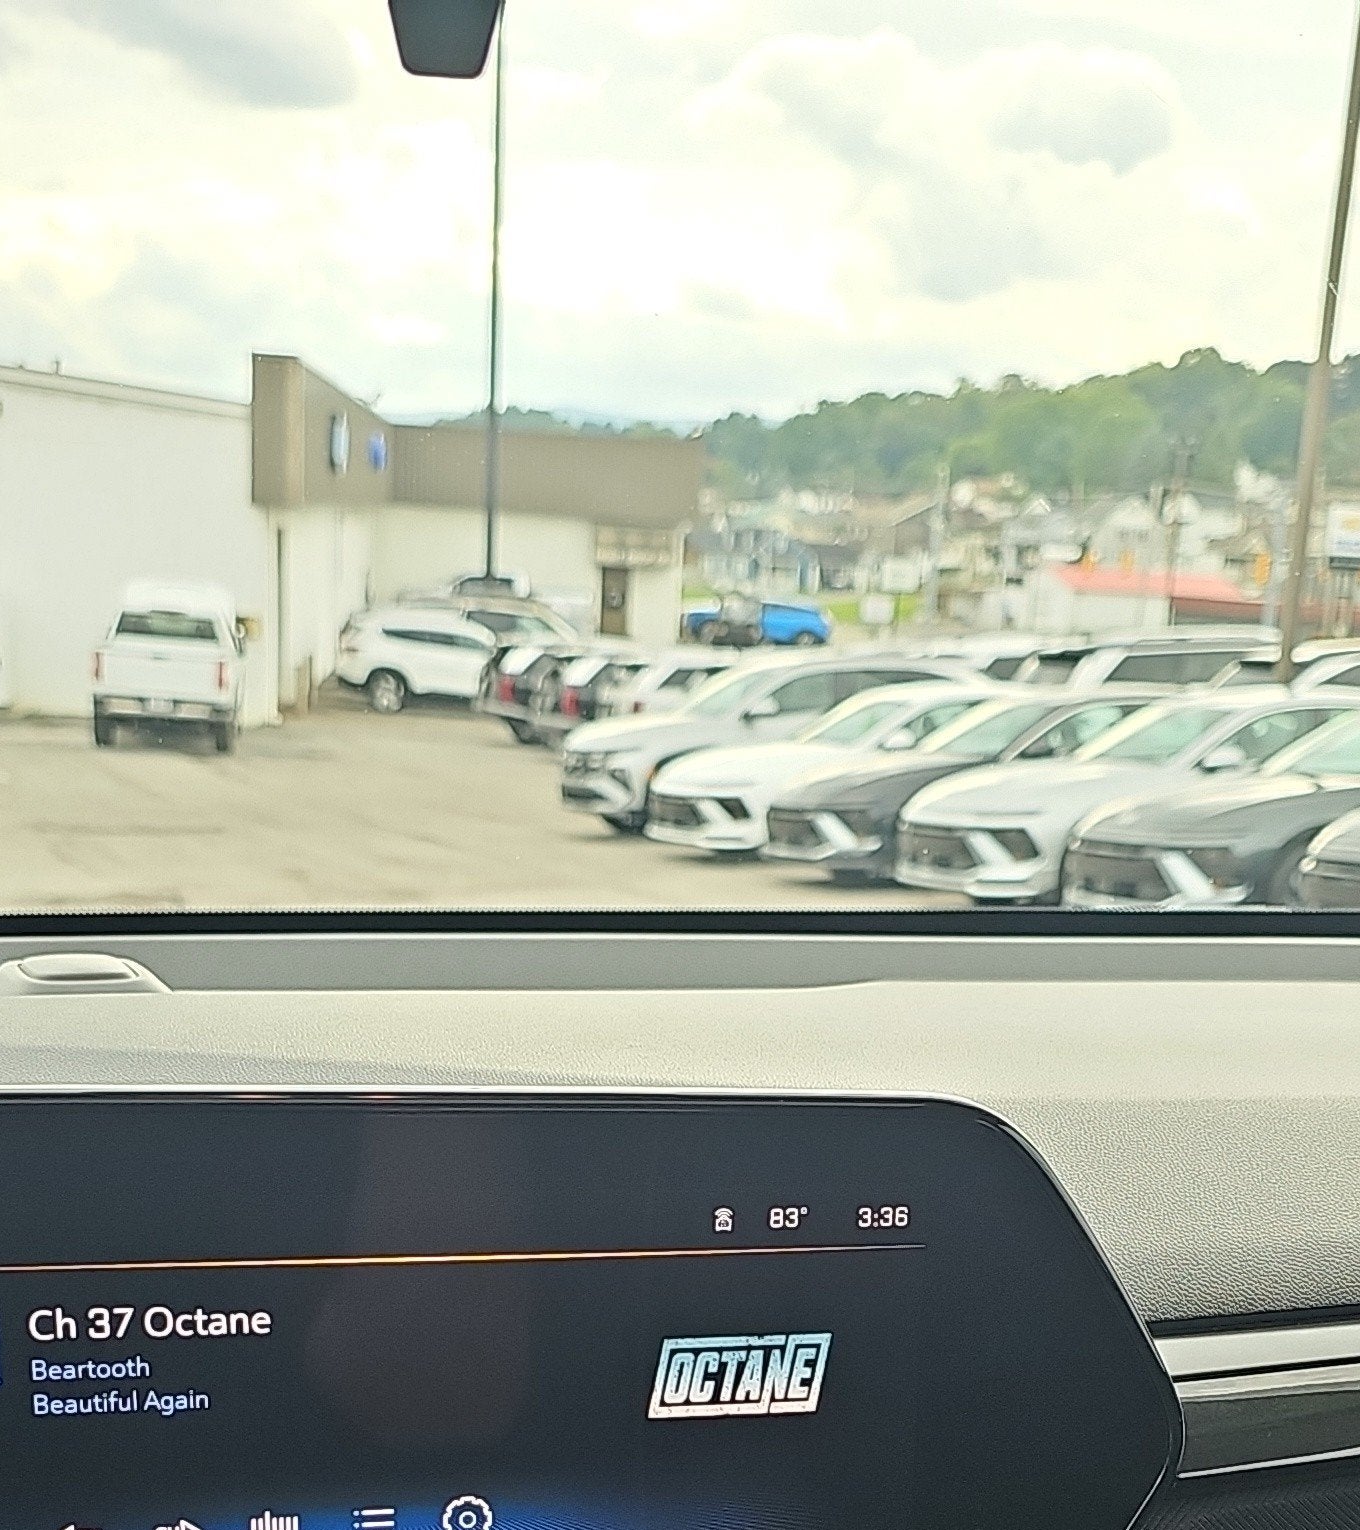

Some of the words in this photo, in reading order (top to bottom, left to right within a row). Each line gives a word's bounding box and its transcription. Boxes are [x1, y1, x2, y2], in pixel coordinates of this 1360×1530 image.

[857, 1205, 910, 1229] 3:36
[28, 1307, 77, 1342] Ch
[88, 1306, 135, 1340] 37
[143, 1305, 273, 1339] Octane
[30, 1356, 151, 1383] Beartooth
[663, 1343, 818, 1405] OCTANE
[32, 1390, 140, 1416] Beautiful
[143, 1389, 210, 1417] Again
